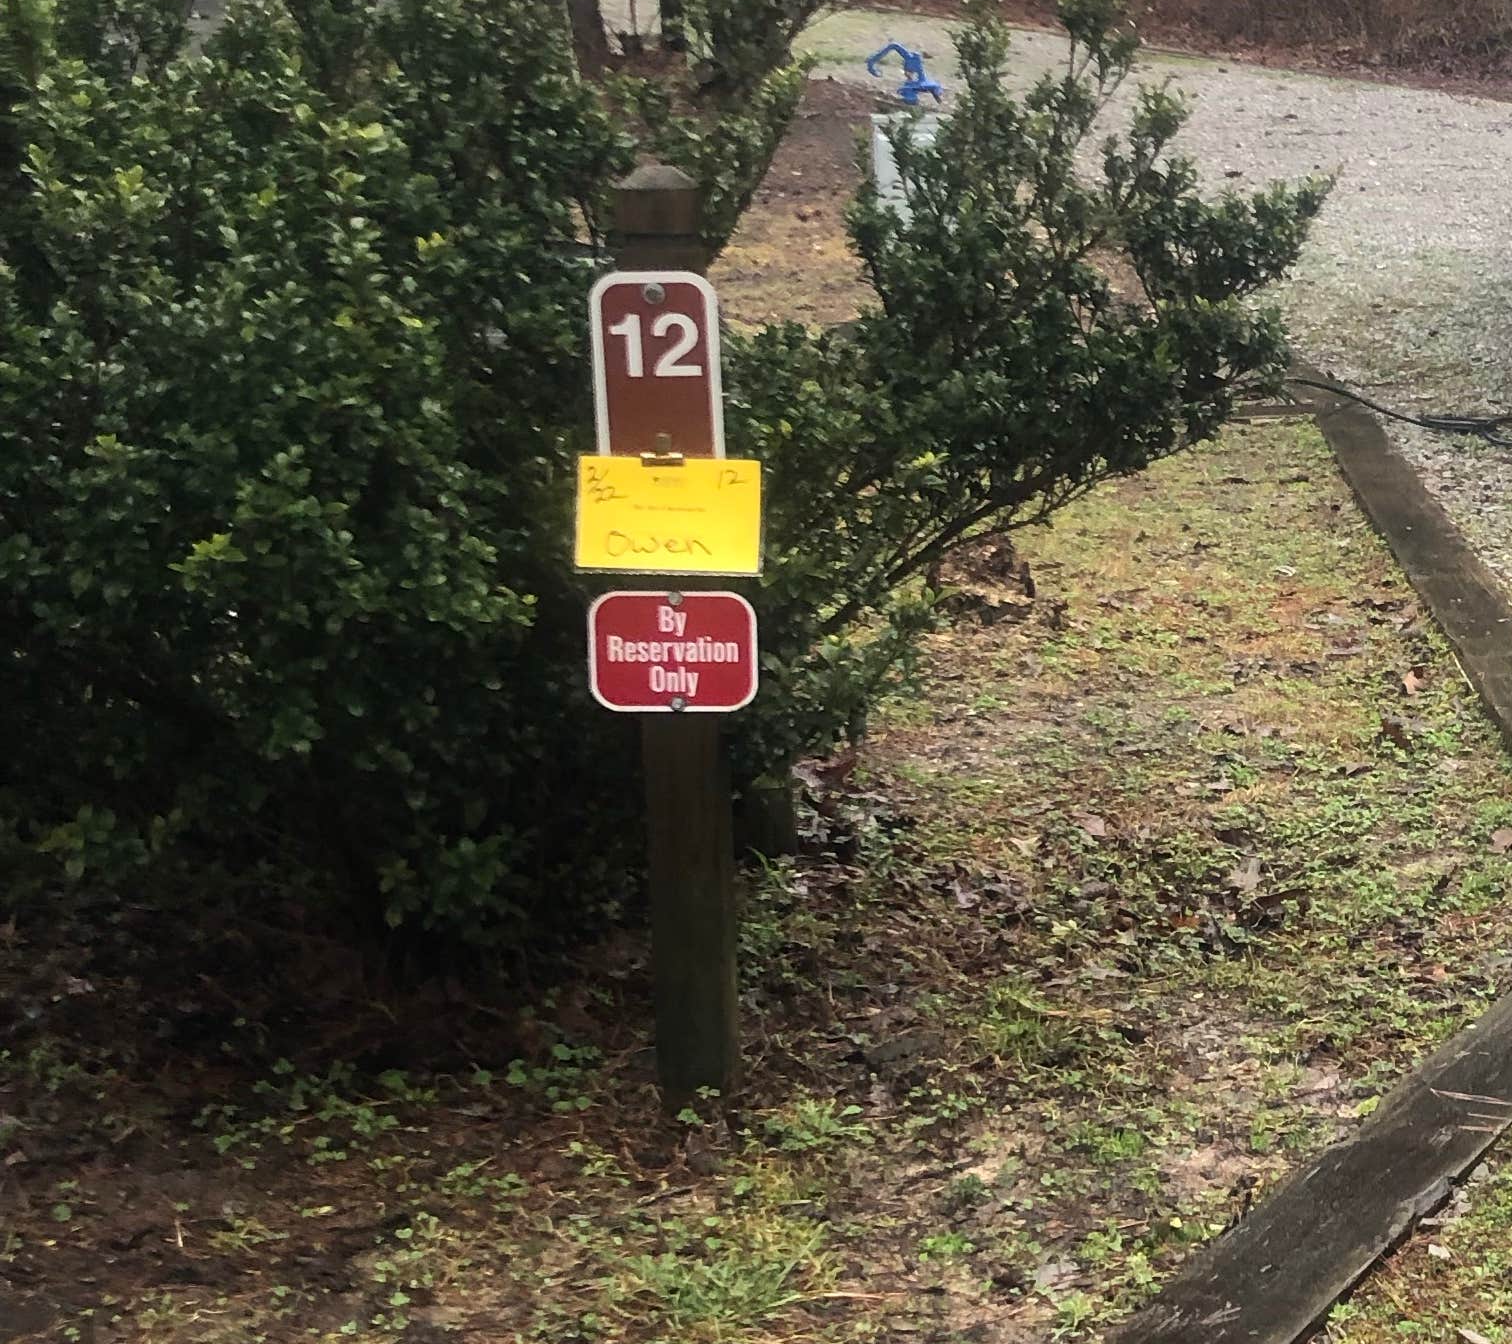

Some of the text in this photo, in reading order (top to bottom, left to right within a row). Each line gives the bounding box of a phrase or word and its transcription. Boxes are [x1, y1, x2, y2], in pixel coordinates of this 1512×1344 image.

[607, 312, 703, 378] 12
[717, 468, 746, 490] 12
[606, 530, 713, 557] Owen
[658, 605, 687, 637] By
[606, 635, 739, 663] Reservation
[649, 665, 700, 697] Only
